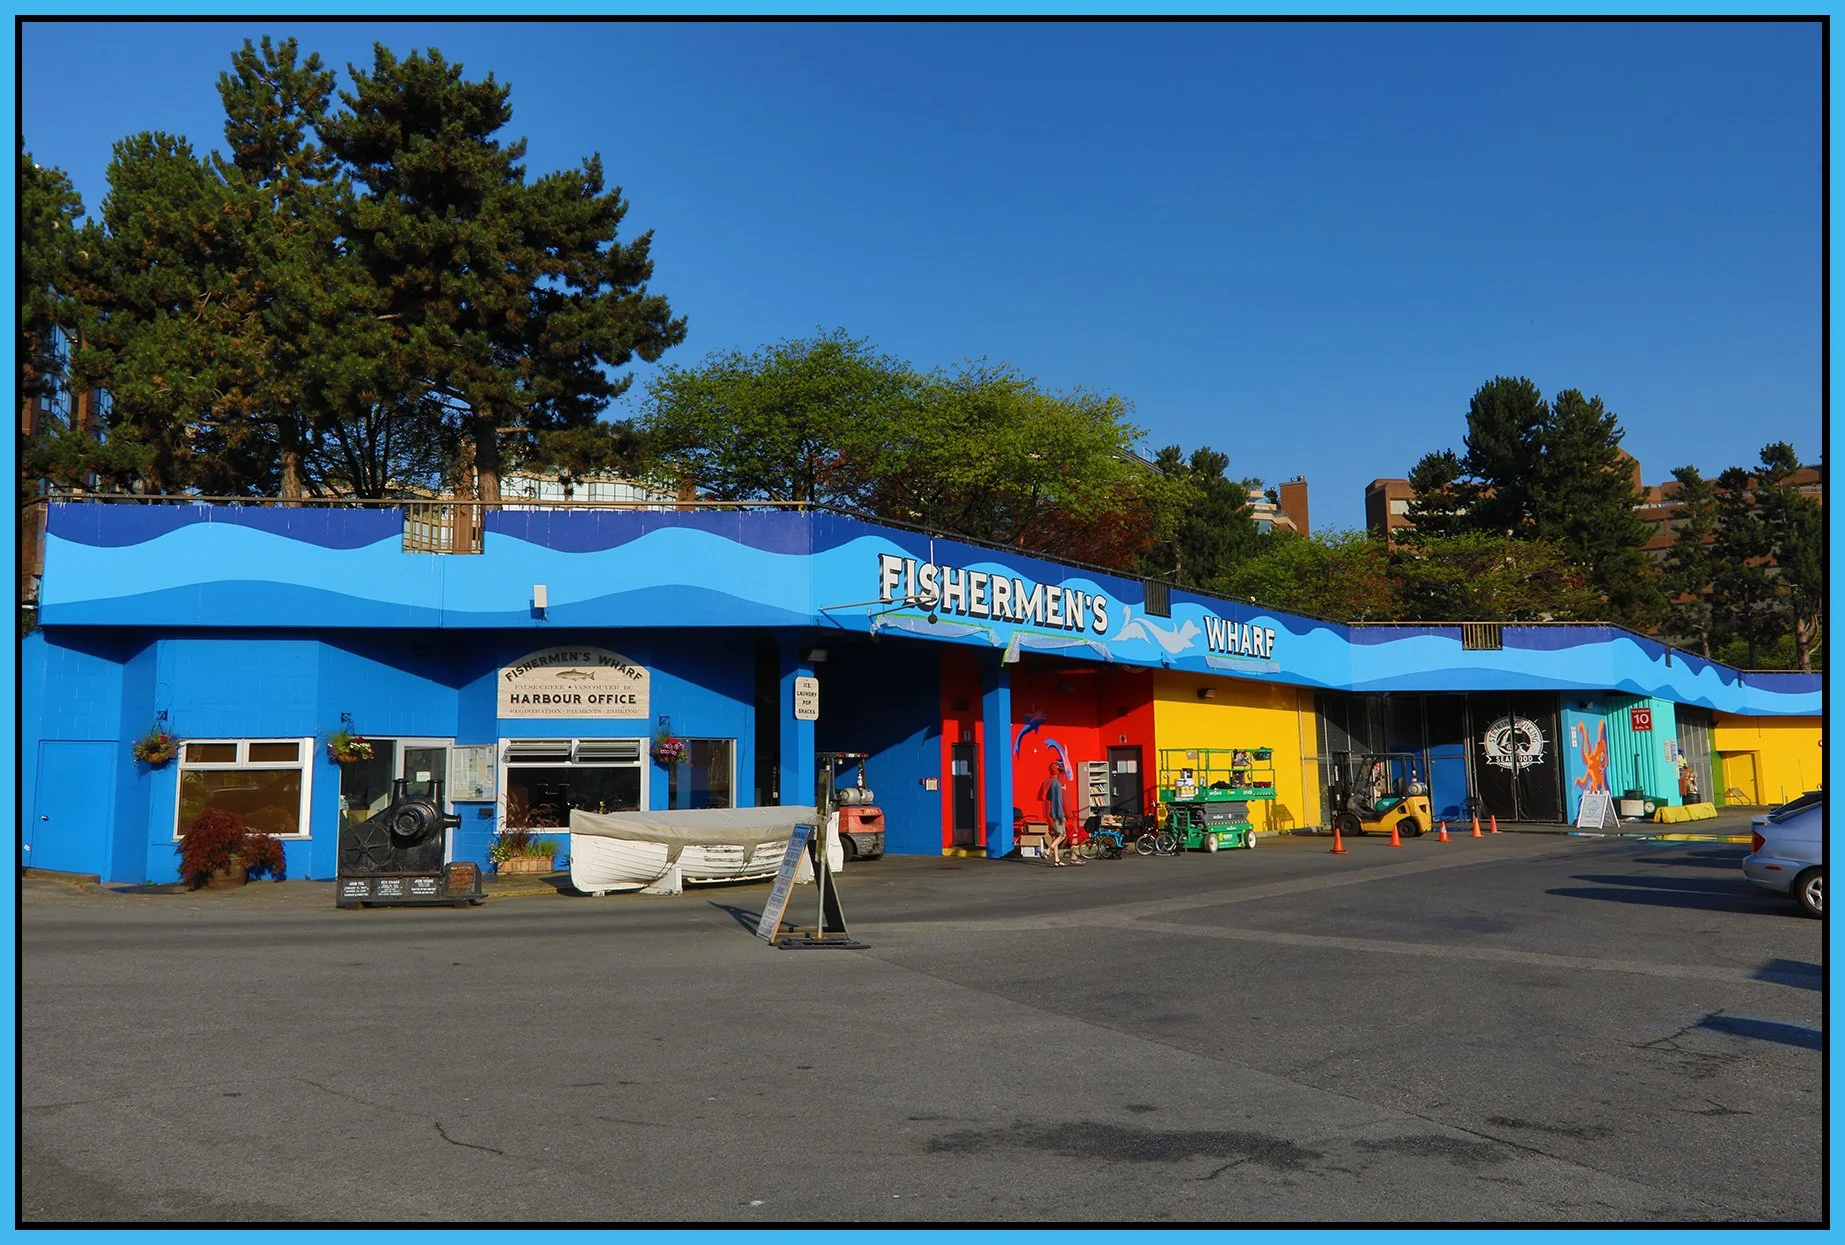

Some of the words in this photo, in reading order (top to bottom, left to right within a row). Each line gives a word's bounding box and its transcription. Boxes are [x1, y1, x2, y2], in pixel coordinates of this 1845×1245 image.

[879, 553, 1108, 635] FISHERMEN'S
[1203, 615, 1276, 658] WHARF
[505, 652, 591, 682] FISHERMEN'S
[598, 654, 643, 682] WHARF
[510, 694, 582, 704] HARBOUR
[587, 694, 637, 704] OFFICE
[1633, 713, 1650, 724] 10
